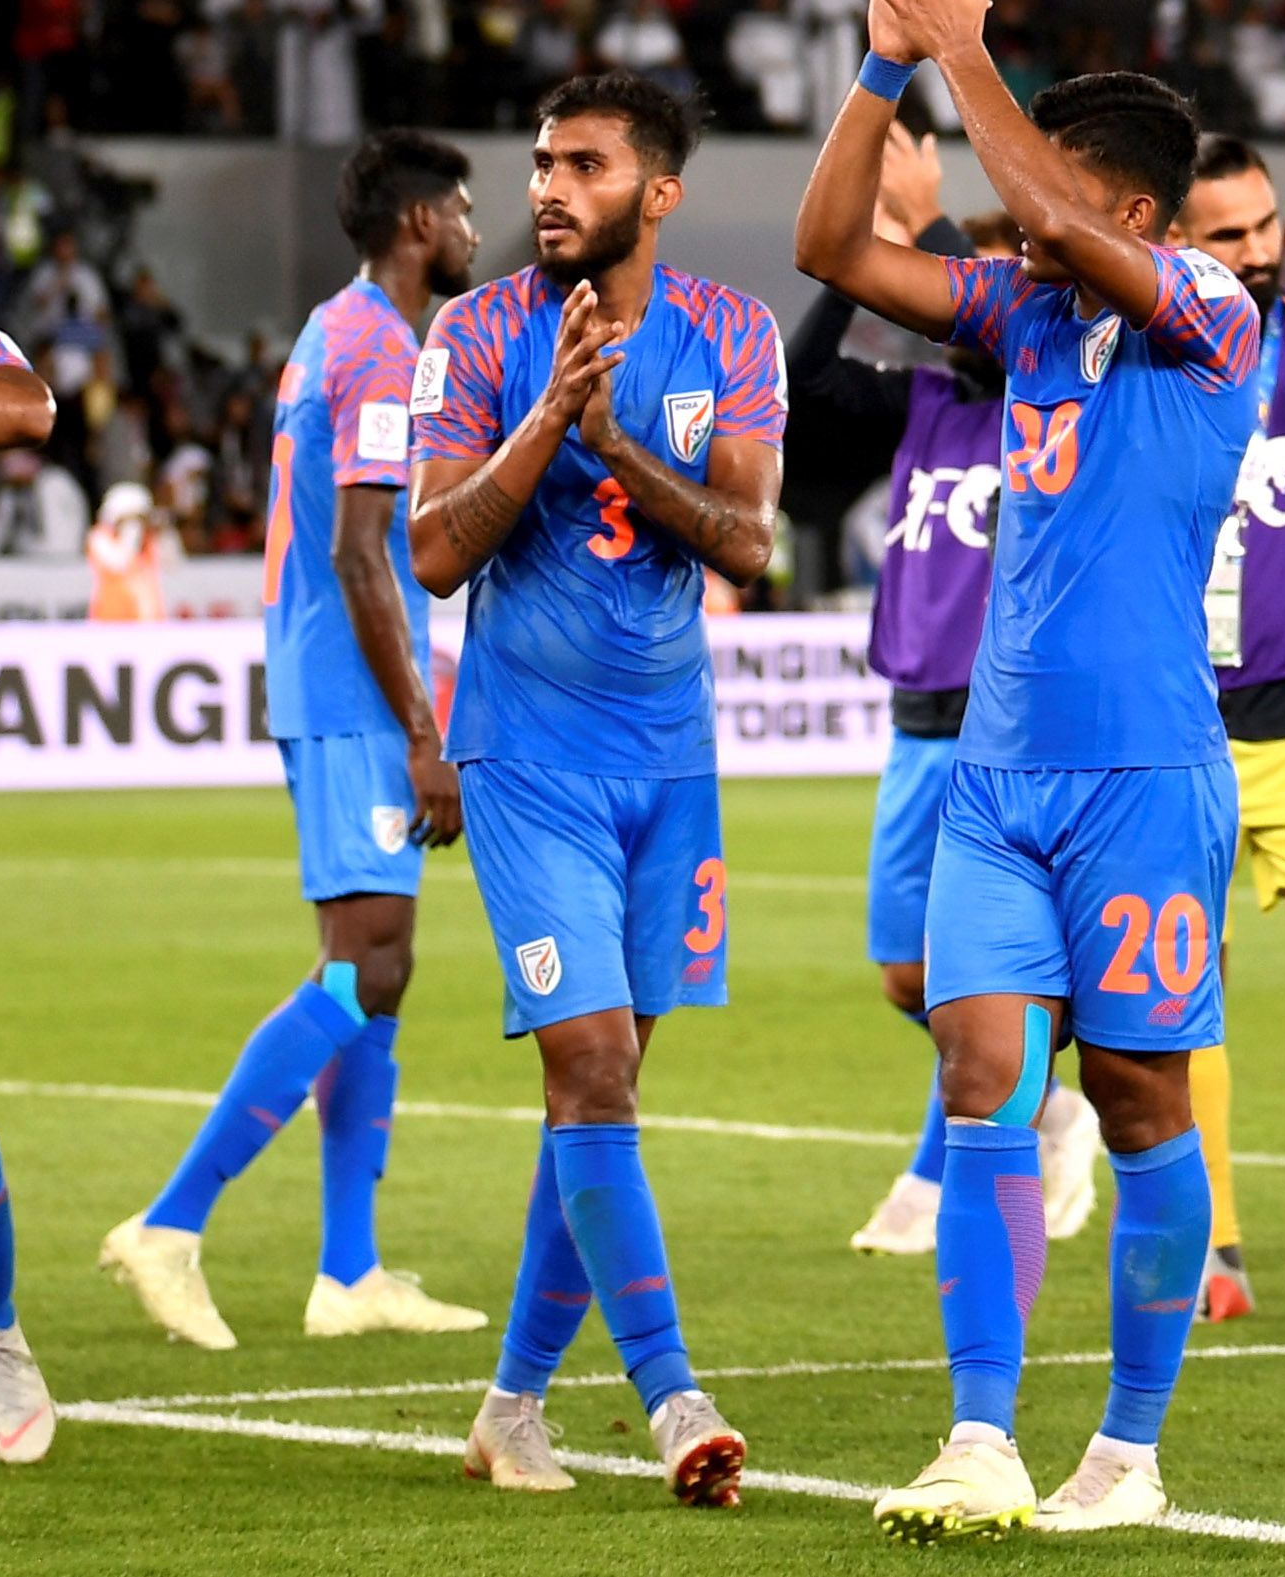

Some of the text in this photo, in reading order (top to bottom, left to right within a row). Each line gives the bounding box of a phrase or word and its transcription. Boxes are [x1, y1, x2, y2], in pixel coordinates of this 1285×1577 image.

[586, 476, 635, 561] 3
[684, 857, 728, 954] 3
[1098, 892, 1209, 996] 20
